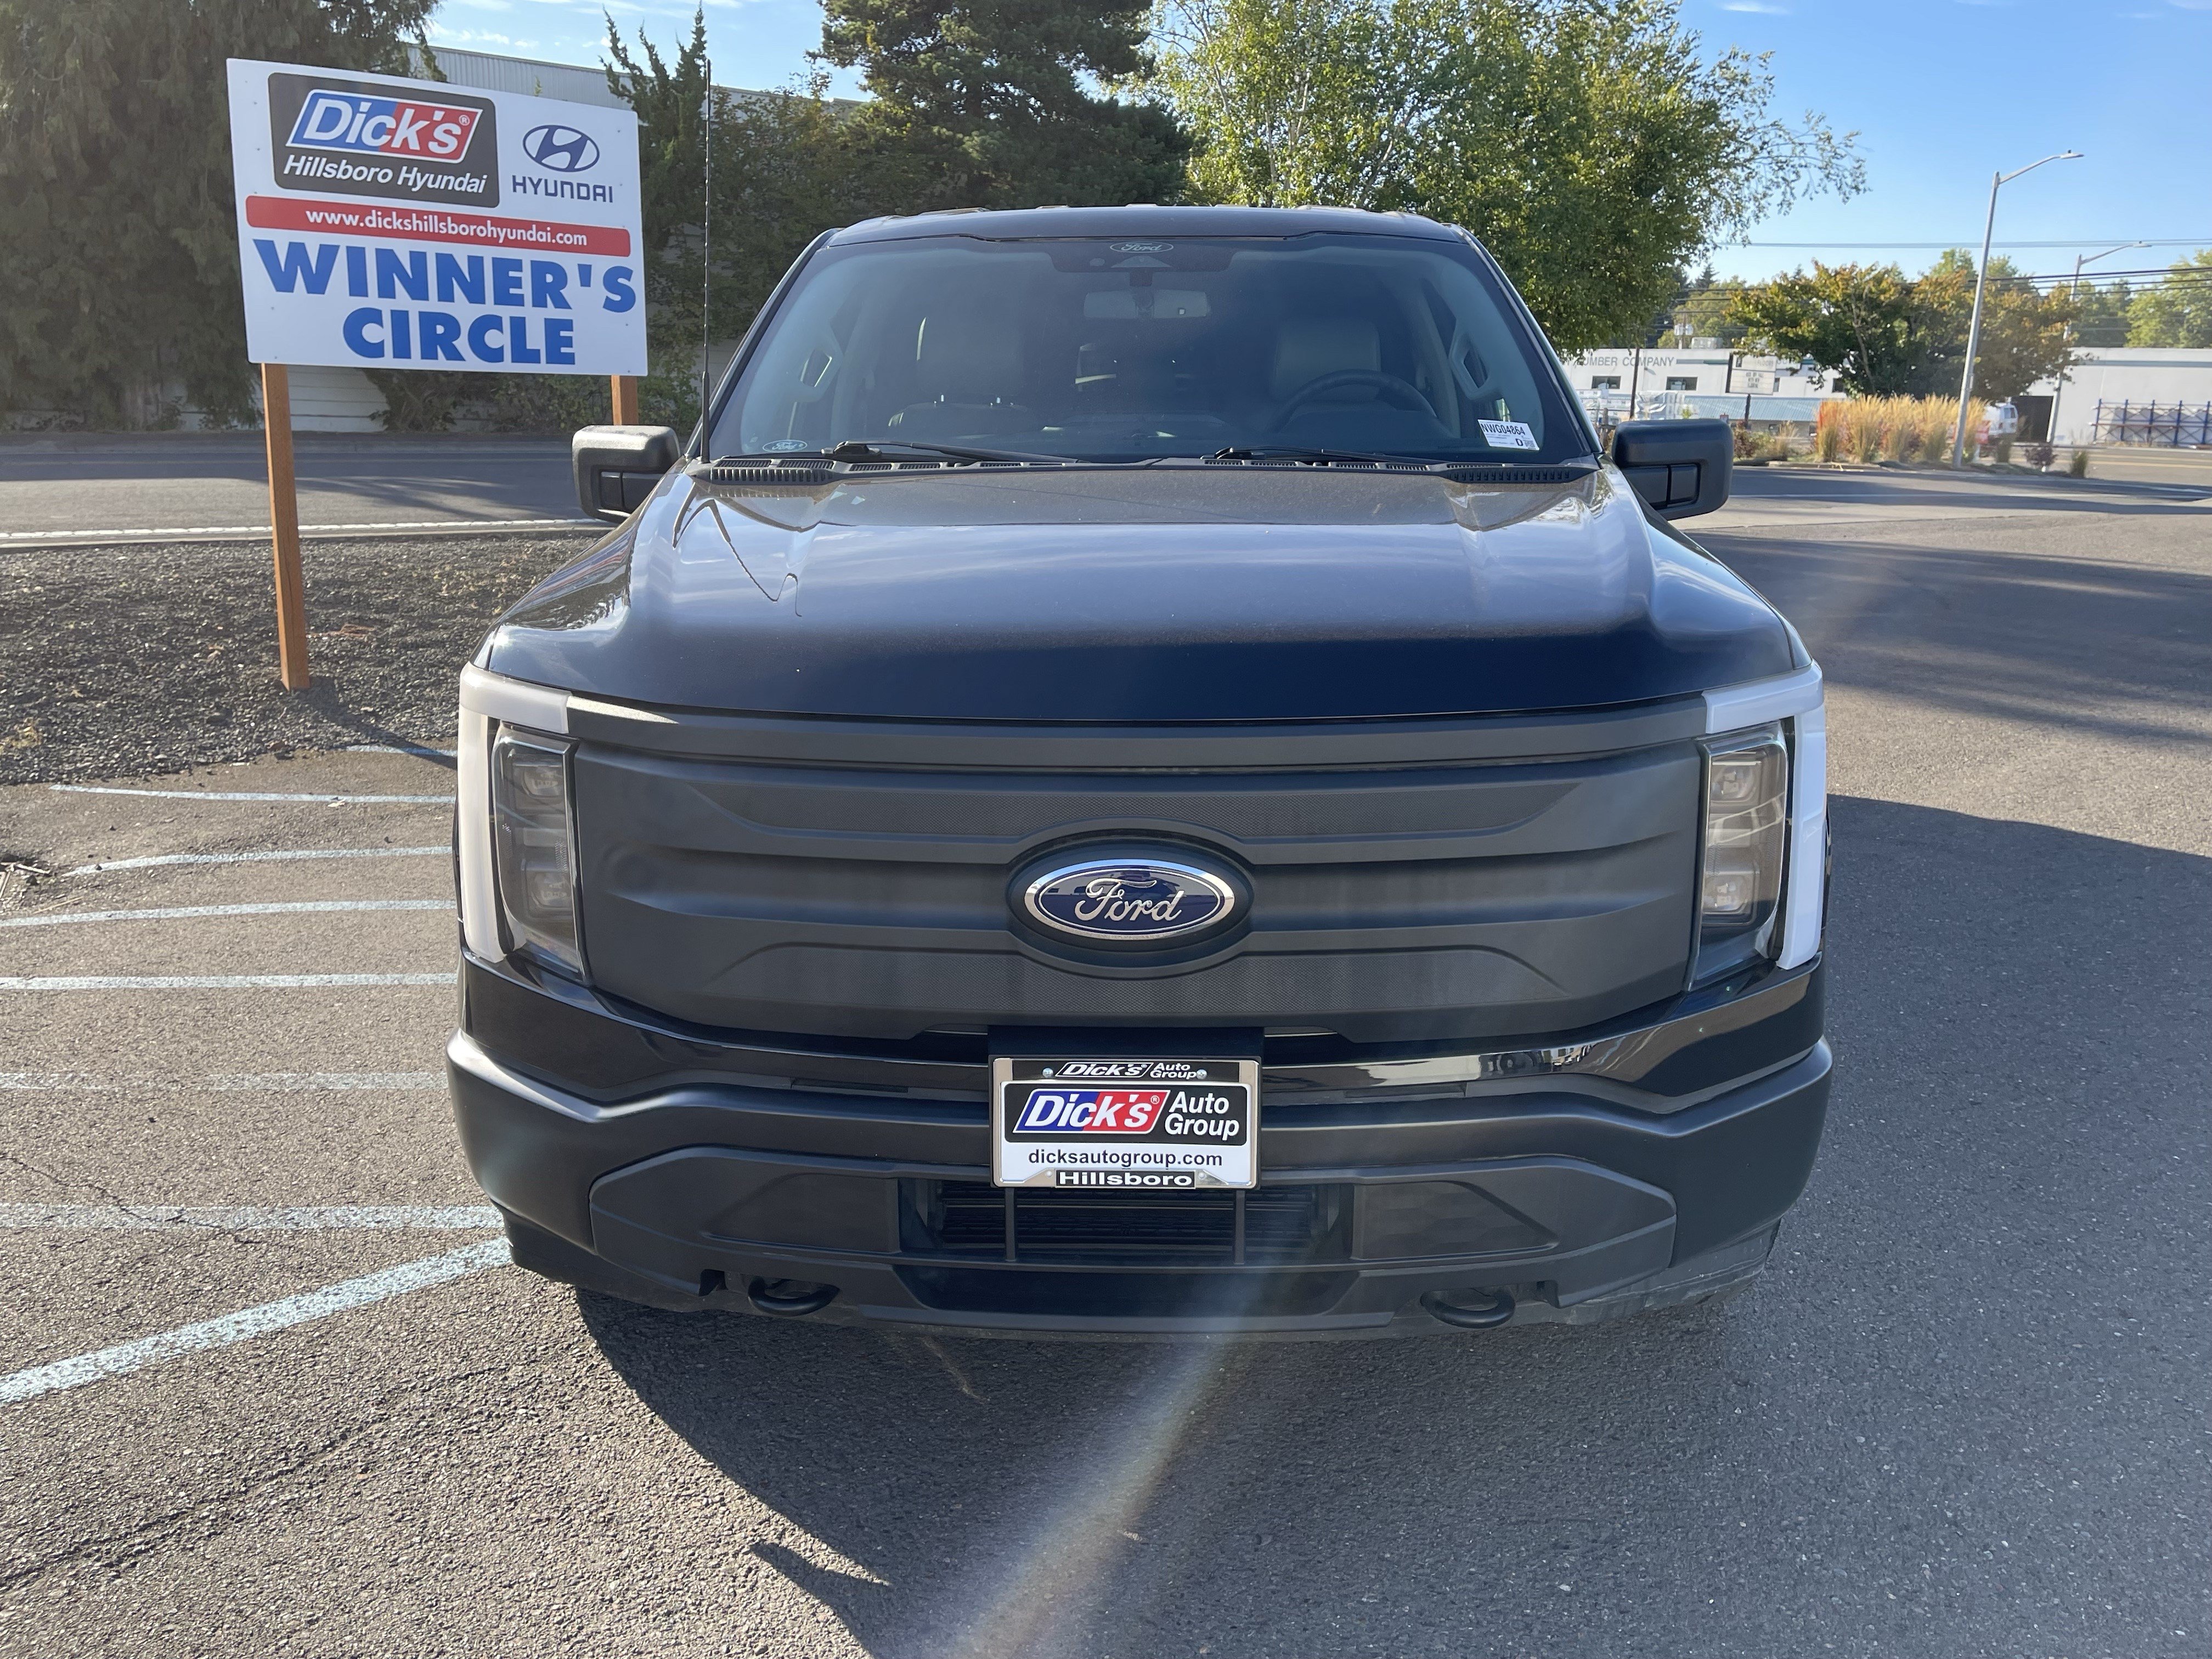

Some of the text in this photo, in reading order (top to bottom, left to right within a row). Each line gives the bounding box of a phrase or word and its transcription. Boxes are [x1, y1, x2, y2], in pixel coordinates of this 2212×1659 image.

[283, 154, 488, 194] Hillsboro Hyundai
[511, 174, 613, 203] HYUNDAI
[305, 208, 588, 246] www.dickshillsborohyundai.com
[1120, 242, 1163, 251] Ford
[253, 238, 637, 313] WINNER'S
[342, 307, 576, 365] CIRCLE
[771, 442, 798, 450] Ford
[1074, 878, 1185, 922] Ford
[1062, 1063, 1143, 1076] Dick's
[1150, 1070, 1197, 1080] Group
[1153, 1062, 1190, 1071] Auto
[1169, 1091, 1229, 1114] Auto
[1164, 1113, 1240, 1141] Group
[1028, 1149, 1222, 1169] dicksautogroup.com
[1059, 1171, 1193, 1186] Hillsboro
